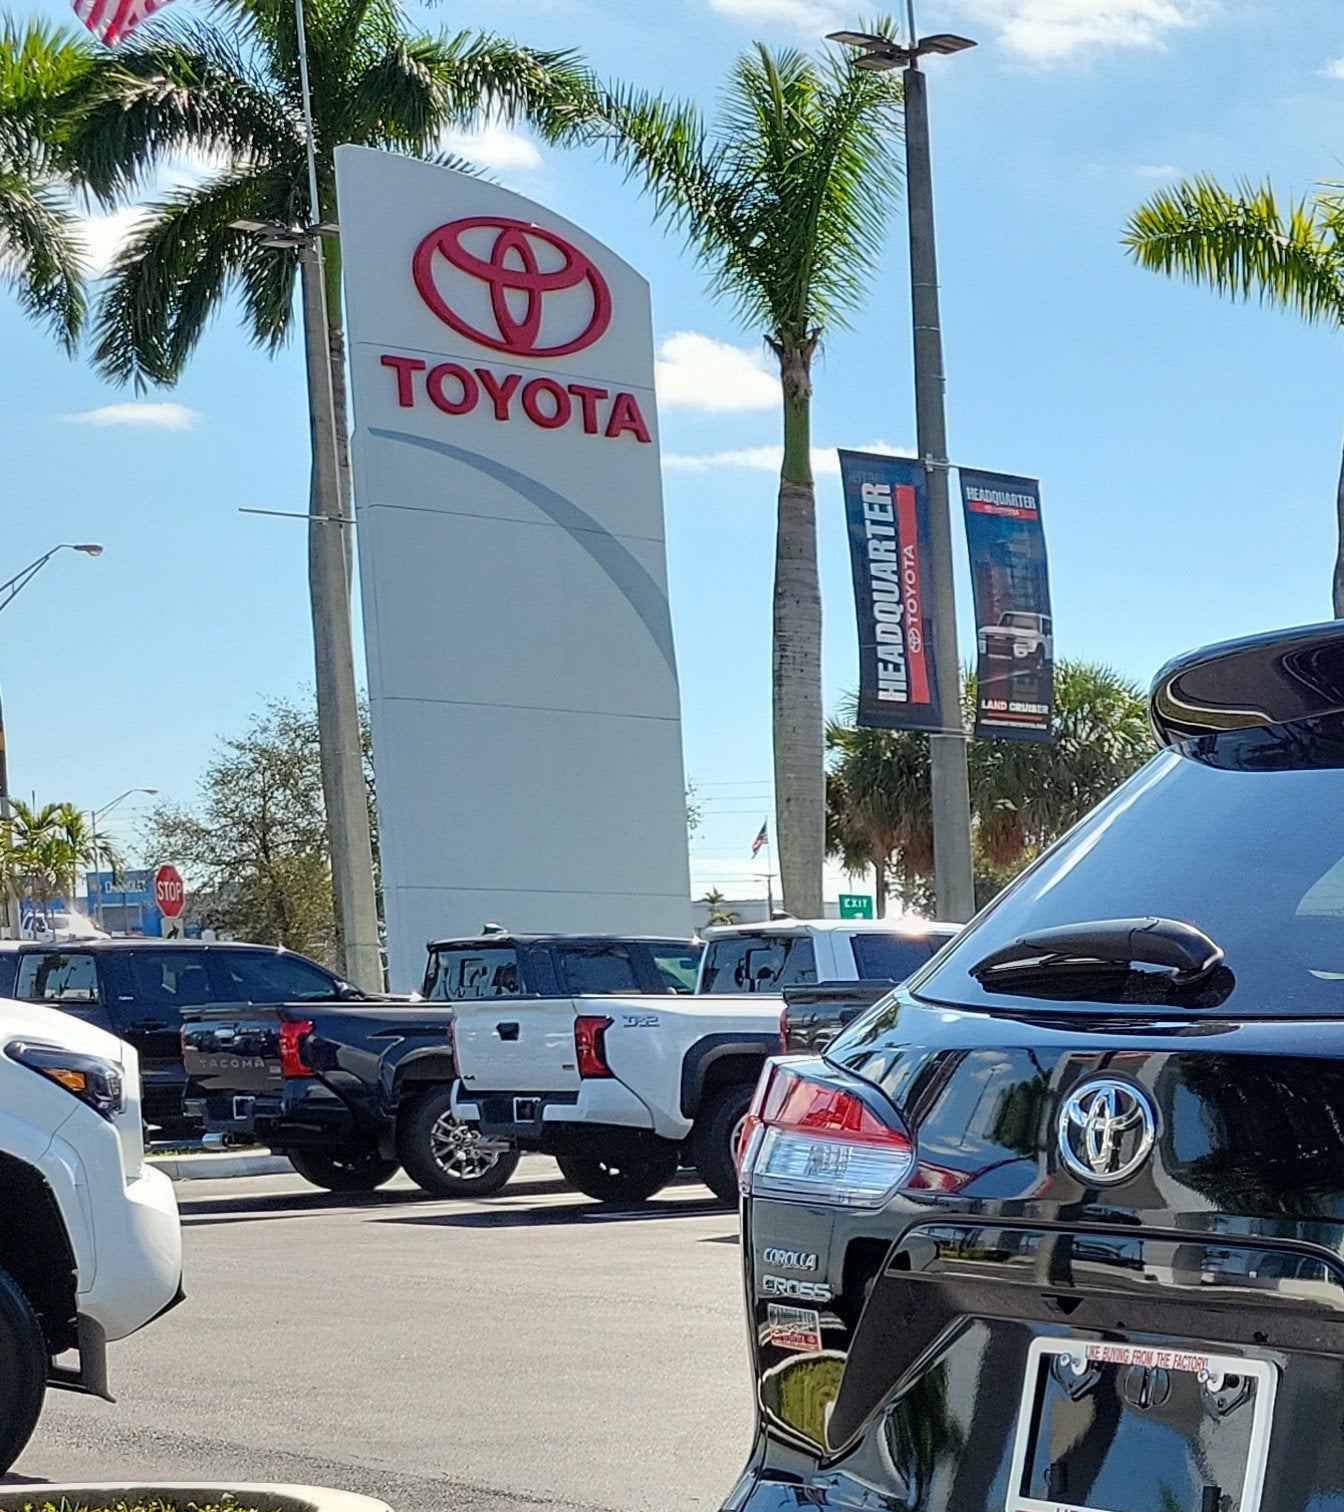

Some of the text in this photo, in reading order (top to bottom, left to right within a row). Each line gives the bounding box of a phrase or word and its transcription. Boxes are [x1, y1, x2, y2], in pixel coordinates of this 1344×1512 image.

[381, 355, 651, 443] TOYOTA
[966, 487, 1036, 509] HEADQUARTER
[861, 482, 907, 702] HEADQUARTER
[903, 544, 922, 626] TOYOTA
[981, 699, 1007, 711] LAND
[157, 881, 181, 901] STOP
[844, 898, 867, 908] EXIT
[200, 1058, 265, 1068] TACOMA
[763, 1247, 818, 1271] COROLLA
[763, 1274, 832, 1302] CROSS
[1103, 1346, 1130, 1364] BUYING
[1131, 1350, 1155, 1367] FROM
[1156, 1353, 1173, 1369] THE
